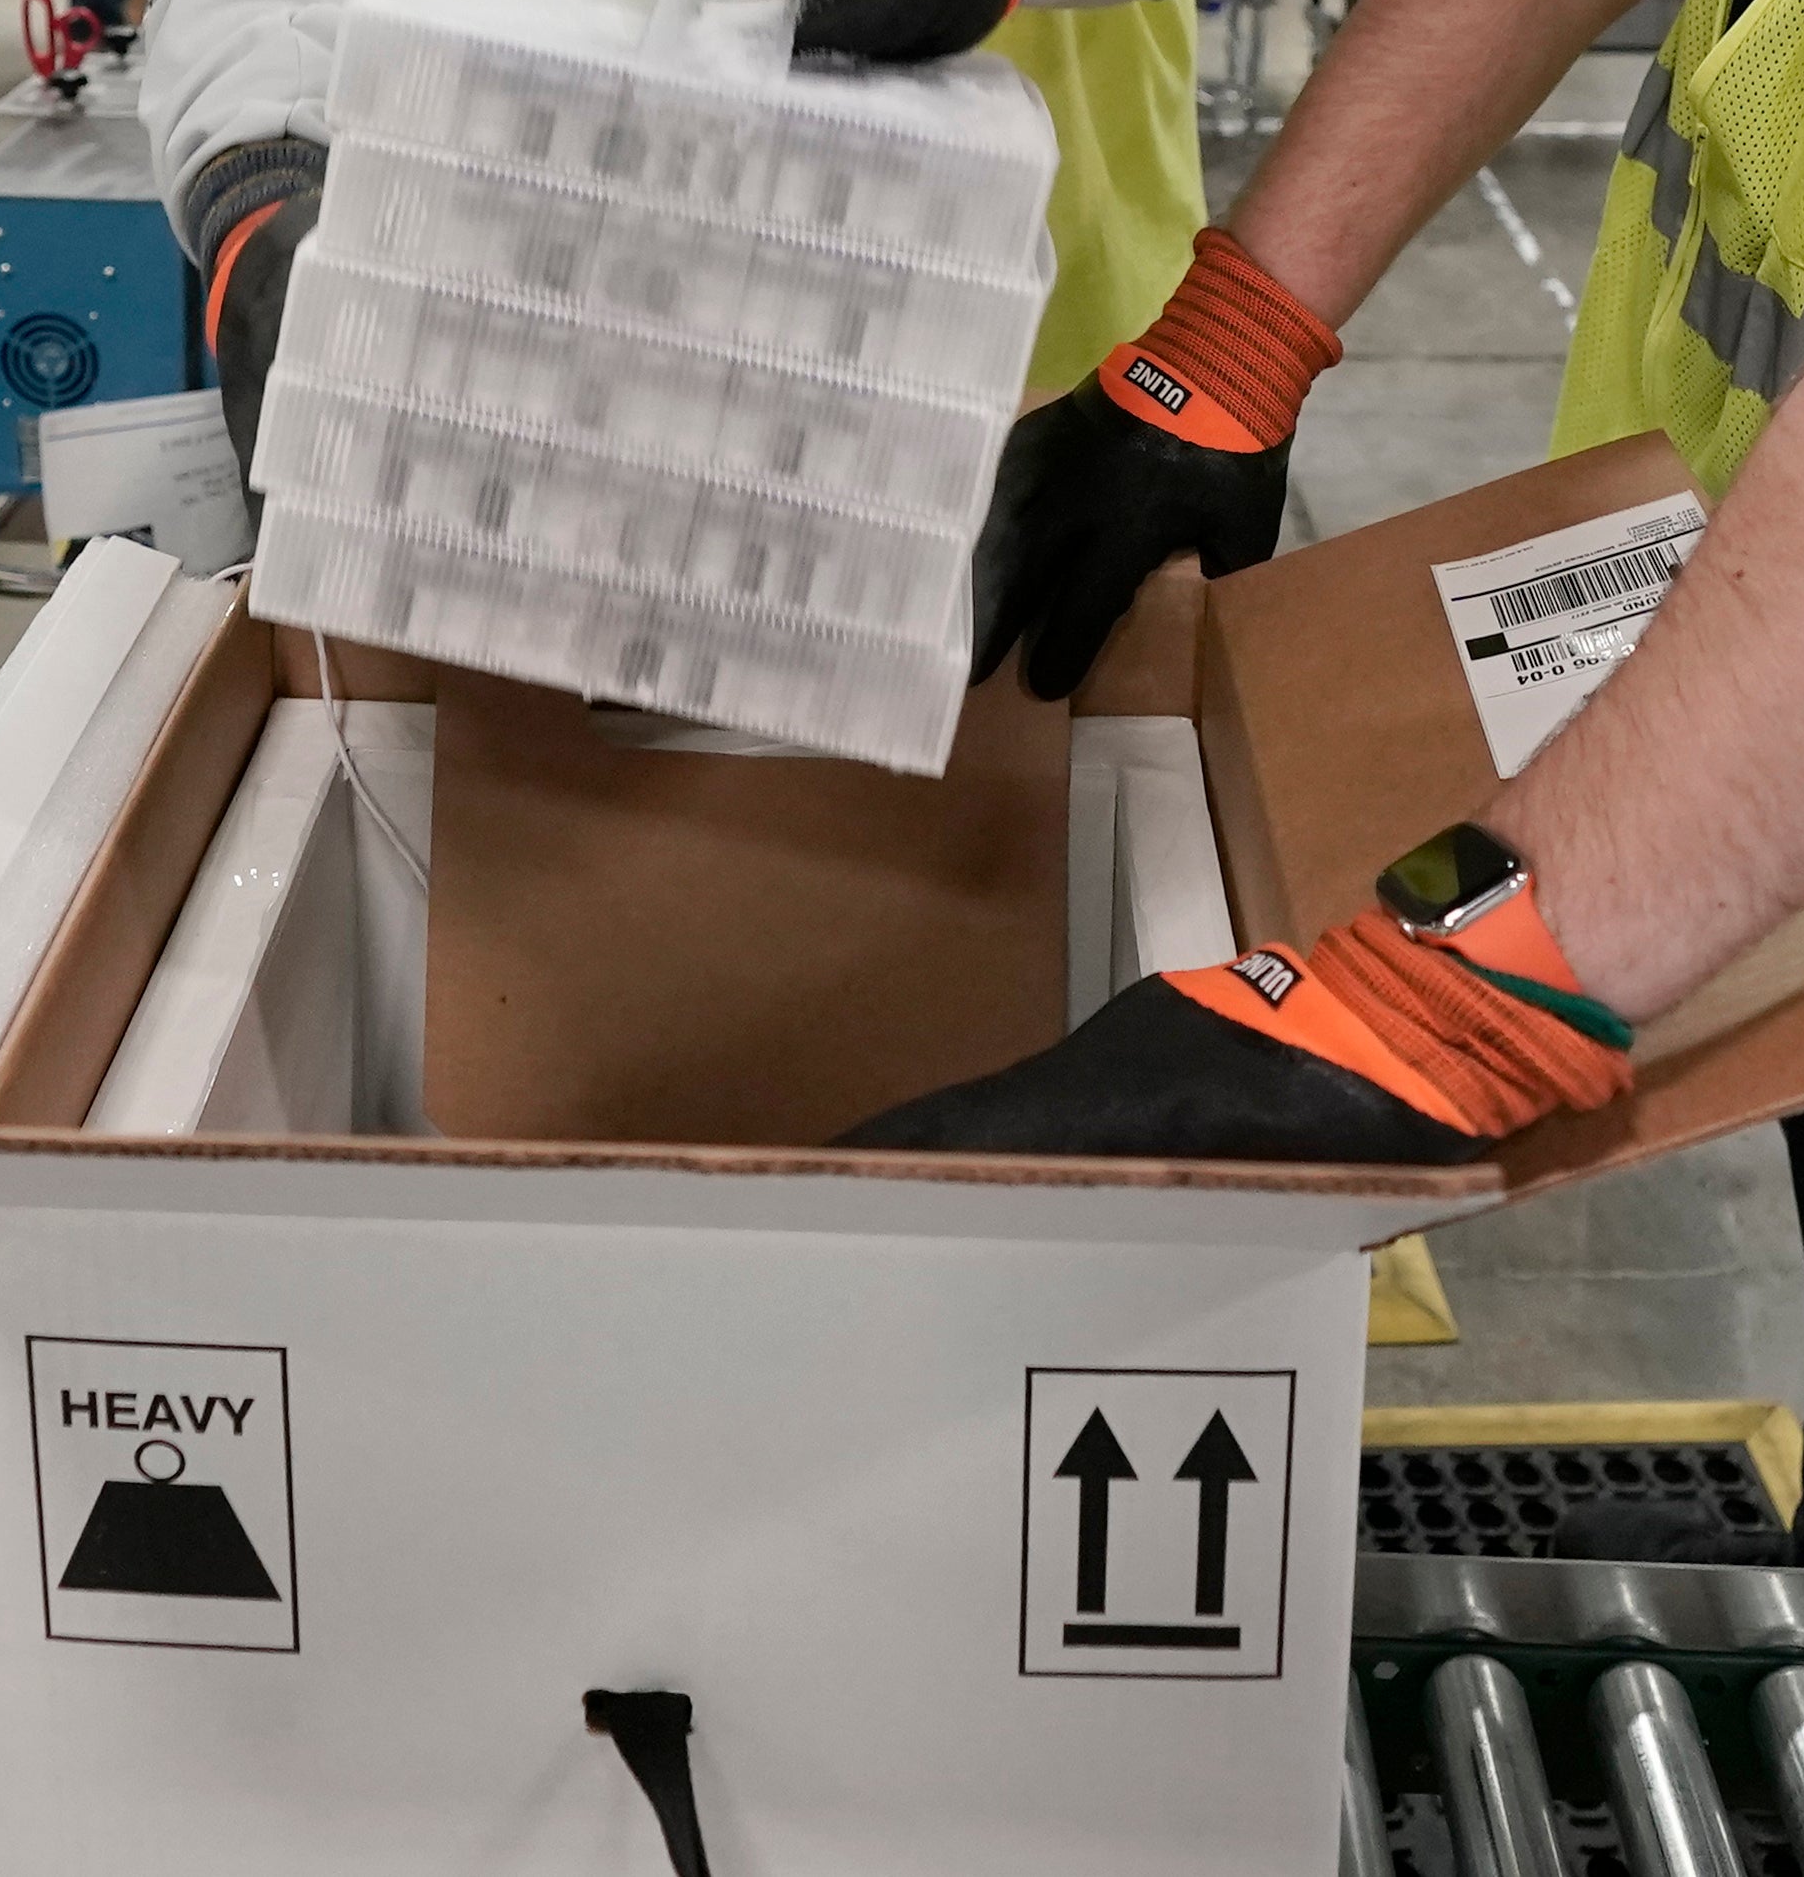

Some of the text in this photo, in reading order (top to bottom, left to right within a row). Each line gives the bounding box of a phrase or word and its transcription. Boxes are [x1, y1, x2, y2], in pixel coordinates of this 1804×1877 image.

[1127, 360, 1186, 410] ULINE
[1517, 665, 1566, 686] 0-04
[60, 1388, 255, 1436] HEAVY
